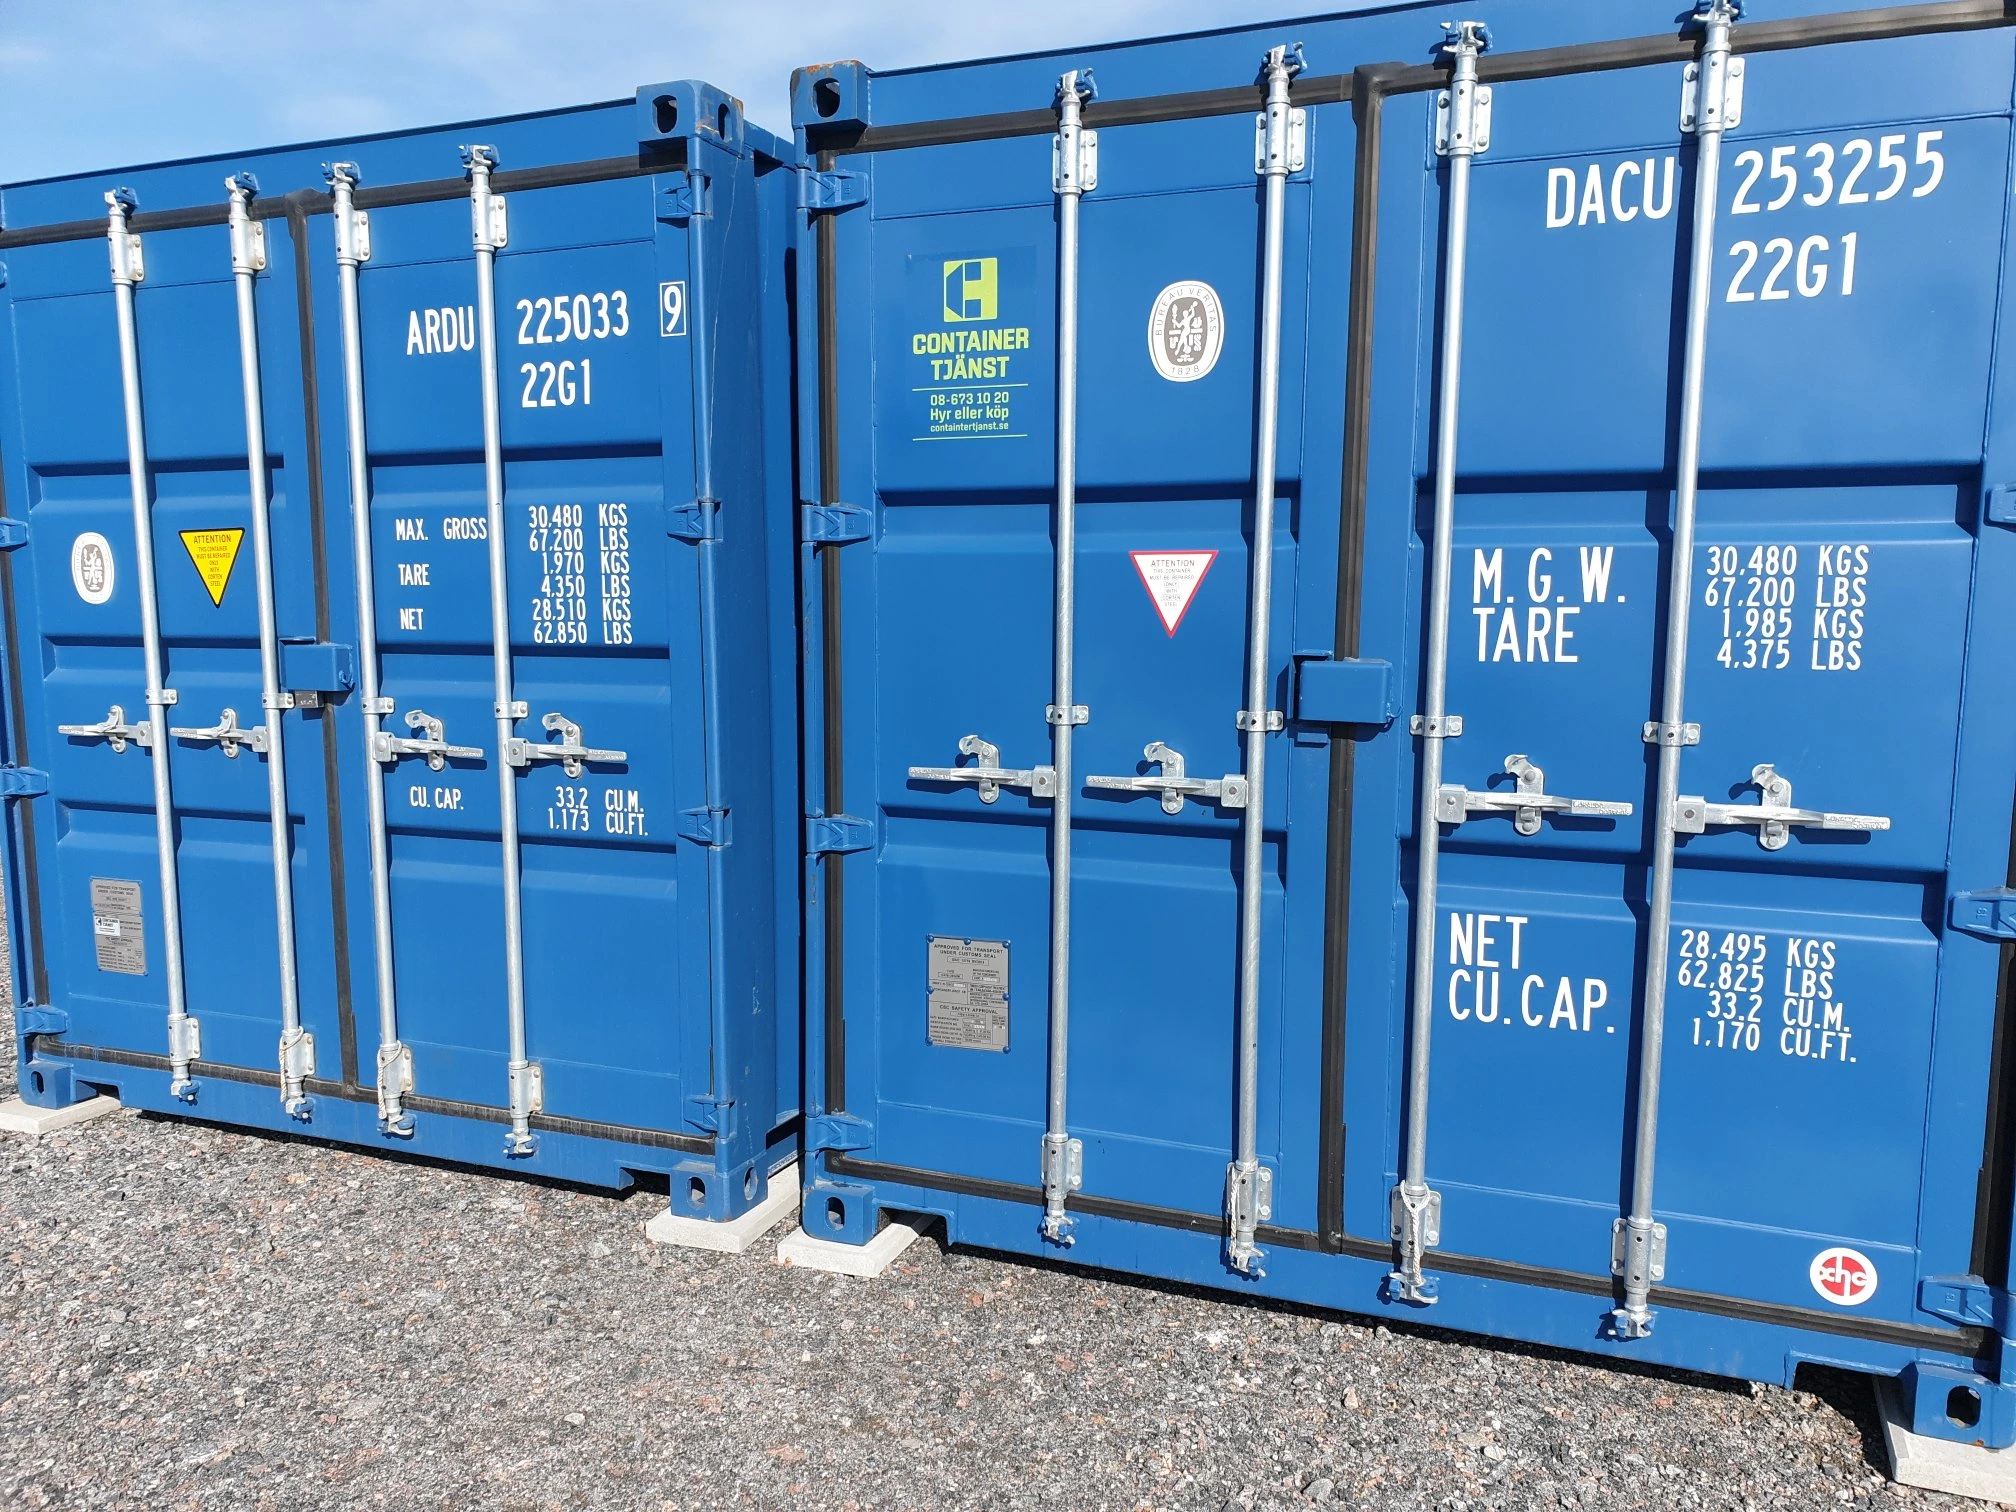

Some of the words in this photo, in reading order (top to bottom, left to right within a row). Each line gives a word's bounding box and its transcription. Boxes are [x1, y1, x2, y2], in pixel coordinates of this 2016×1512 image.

[1547, 157, 1675, 228] DACU
[1731, 131, 1944, 215] 253255
[1726, 232, 1857, 302] 22G1
[407, 306, 475, 355] ARDU
[517, 291, 629, 344] 225033
[664, 286, 682, 332] 9
[1155, 289, 1183, 336] BUREAU
[1189, 288, 1216, 332] VERITAS
[912, 327, 1029, 354] CONTAINER
[931, 355, 1009, 380] TJÄNST
[1171, 365, 1200, 375] 1828
[521, 359, 590, 407] 22G1
[930, 393, 973, 406] 08-673
[977, 392, 990, 404] 10
[994, 391, 1009, 403] 20
[930, 408, 951, 423] Hyr
[954, 407, 982, 419] eller
[986, 405, 1009, 420] köp
[396, 518, 428, 540] MAX.
[443, 518, 487, 539] GROSS
[599, 504, 627, 527] KGS
[194, 534, 231, 544] ATTENTION
[600, 528, 628, 550] LBS
[601, 551, 629, 574] KGS
[1151, 559, 1195, 567] ATTENTION
[1706, 545, 1798, 576] 30,480
[1818, 545, 1869, 575] KGS
[398, 564, 429, 585] TARE
[602, 575, 630, 598] LBS
[1705, 576, 1795, 607] 67,200
[1816, 577, 1867, 607] LBS
[400, 609, 423, 629] NET
[603, 599, 631, 621] KGS
[1723, 608, 1792, 638] 1,985
[1814, 608, 1864, 639] KGS
[604, 622, 632, 644] LBS
[1473, 607, 1580, 662] TARE
[1717, 639, 1790, 669] 4,375
[1812, 640, 1861, 671] LBS
[410, 786, 430, 807] CU.
[435, 788, 463, 810] CAP.
[556, 786, 589, 809] 33.2
[605, 789, 643, 813] CU.M.
[548, 807, 589, 832] 1,173
[606, 812, 648, 836] CU.FT.
[1450, 912, 1527, 970] NET
[1680, 929, 1766, 963] 28,495
[1787, 938, 1836, 970] KGS
[1678, 959, 1764, 993] 62,825
[1785, 968, 1833, 1000] LBS
[1707, 990, 1763, 1023] 33.2
[1783, 998, 1850, 1032] CU.M.
[1694, 1017, 1760, 1051] 1,170
[1780, 1027, 1857, 1063] CU.FT.
